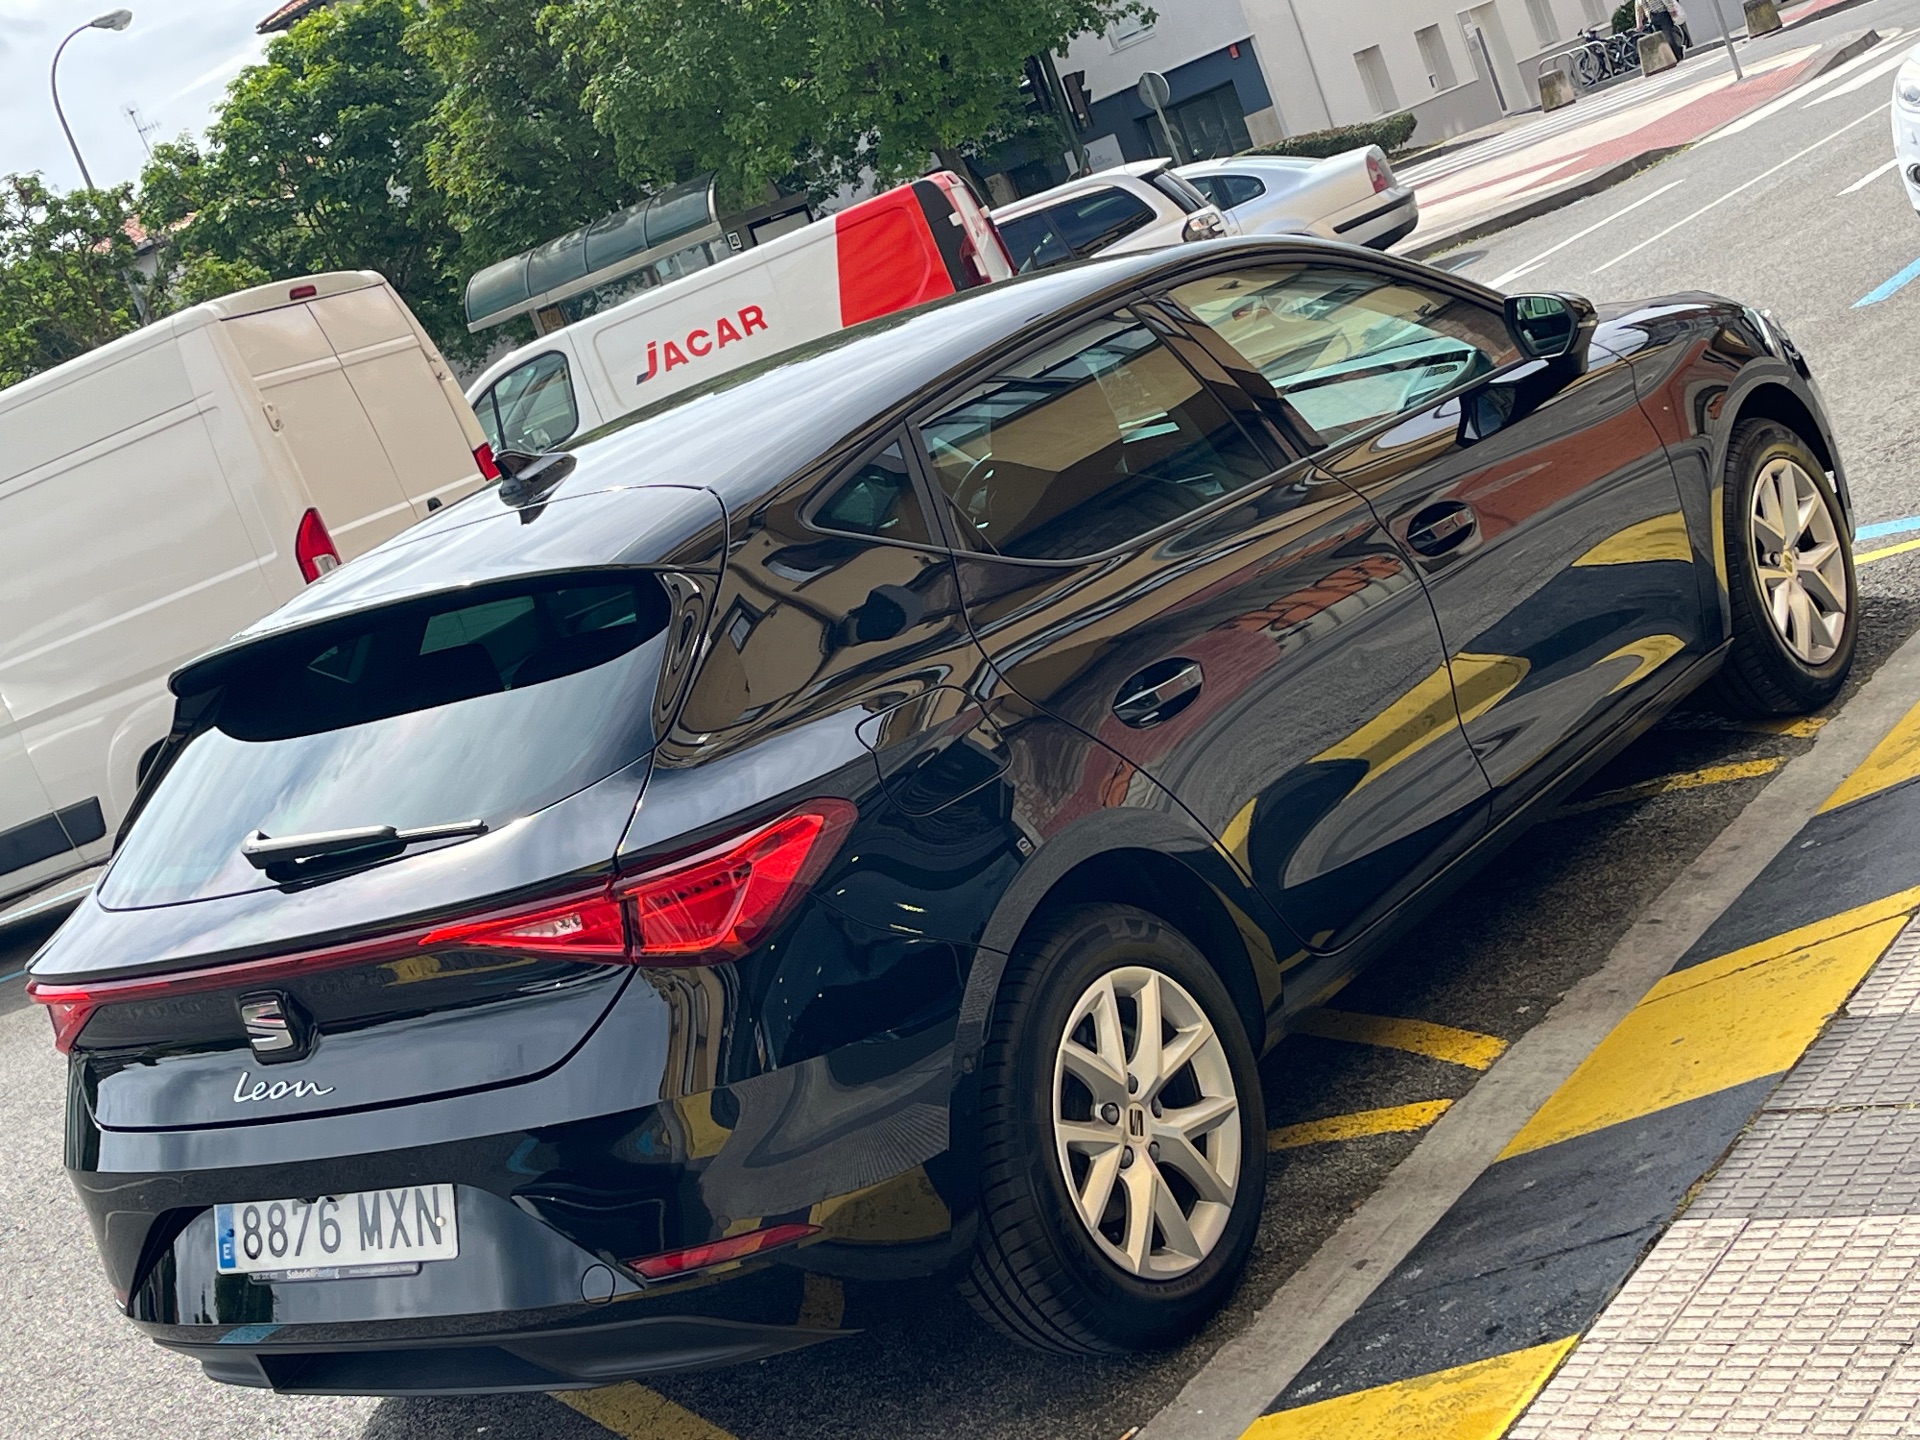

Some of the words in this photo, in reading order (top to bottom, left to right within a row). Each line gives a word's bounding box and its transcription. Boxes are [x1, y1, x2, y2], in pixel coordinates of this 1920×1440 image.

[233, 1071, 334, 1102] Leon
[243, 1199, 342, 1260] 8876
[357, 1186, 443, 1251] MXN
[222, 1243, 231, 1260] E
